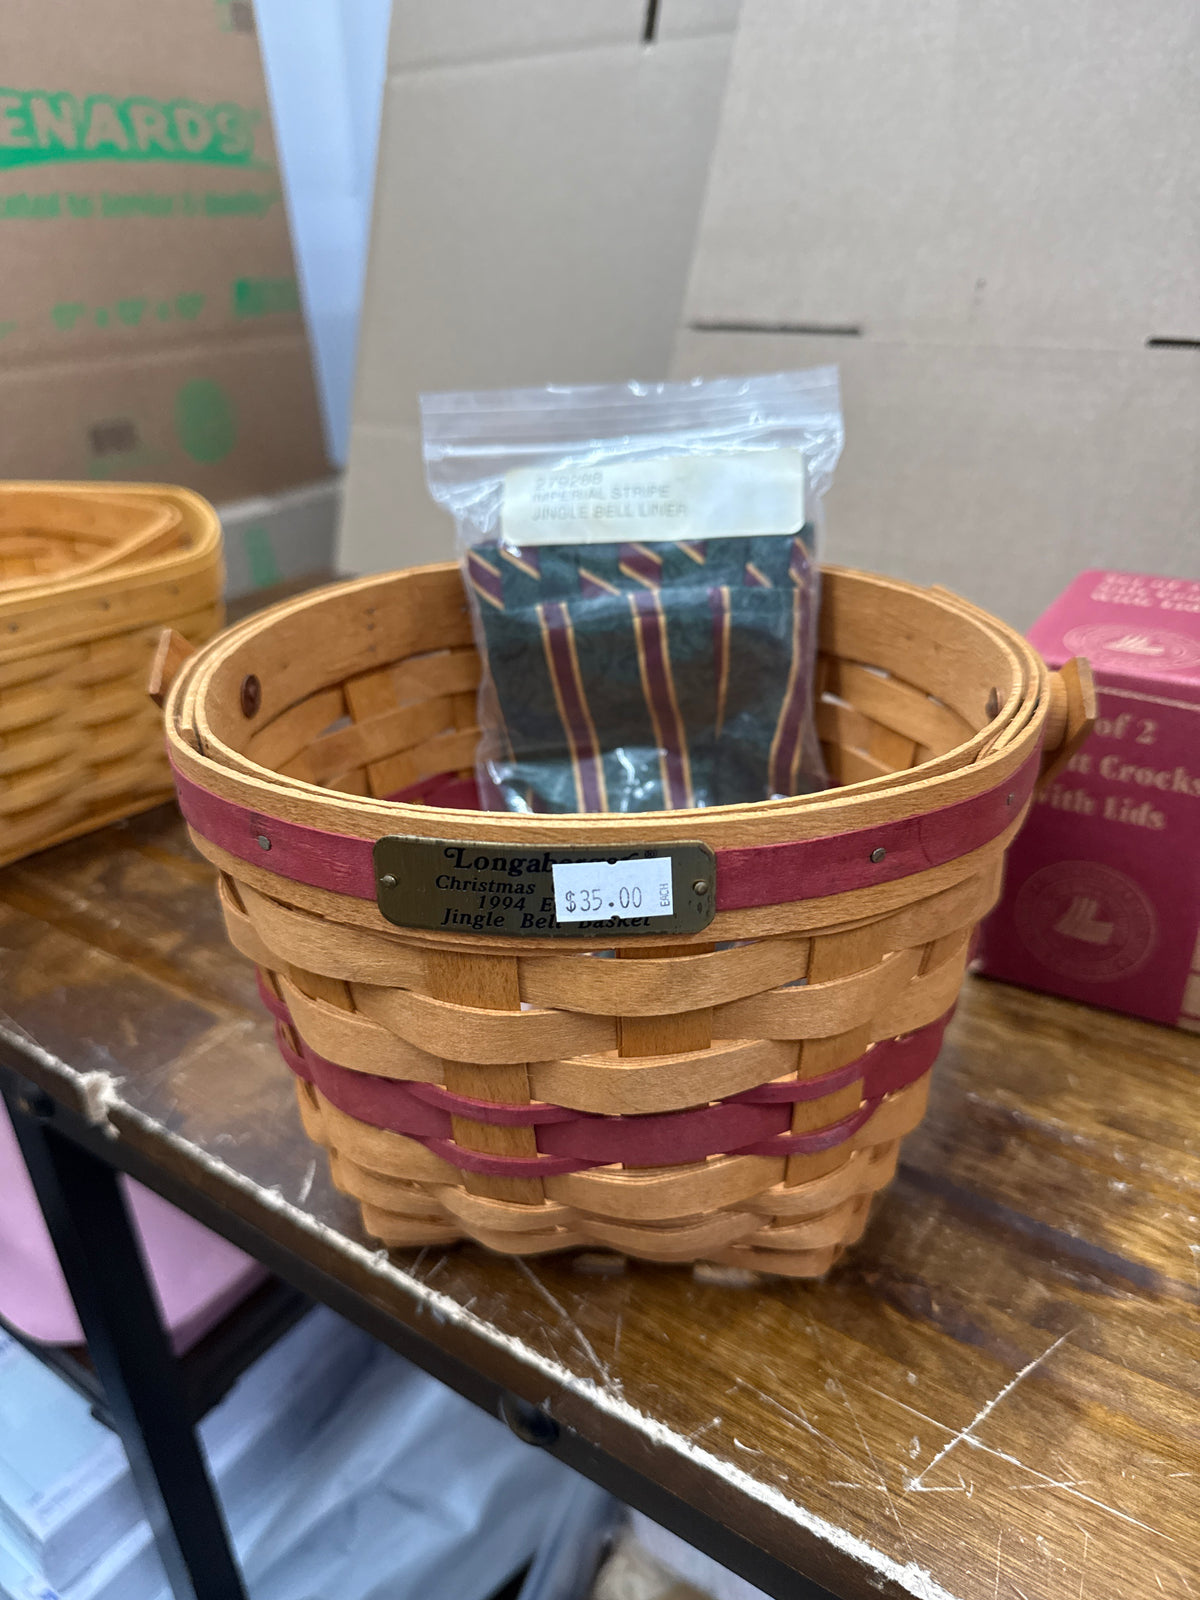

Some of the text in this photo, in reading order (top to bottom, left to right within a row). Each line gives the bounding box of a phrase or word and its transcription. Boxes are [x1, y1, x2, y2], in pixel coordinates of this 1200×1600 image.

[610, 483, 671, 499] STRIPE
[532, 500, 688, 521] JINGLE BELL LINER
[1135, 717, 1160, 745] 2
[443, 847, 639, 877] Longab
[435, 875, 536, 895] Christmas
[659, 883, 671, 907] EACH
[479, 895, 526, 912] 1994
[565, 887, 642, 913] $35.00
[441, 908, 505, 930] Jingle
